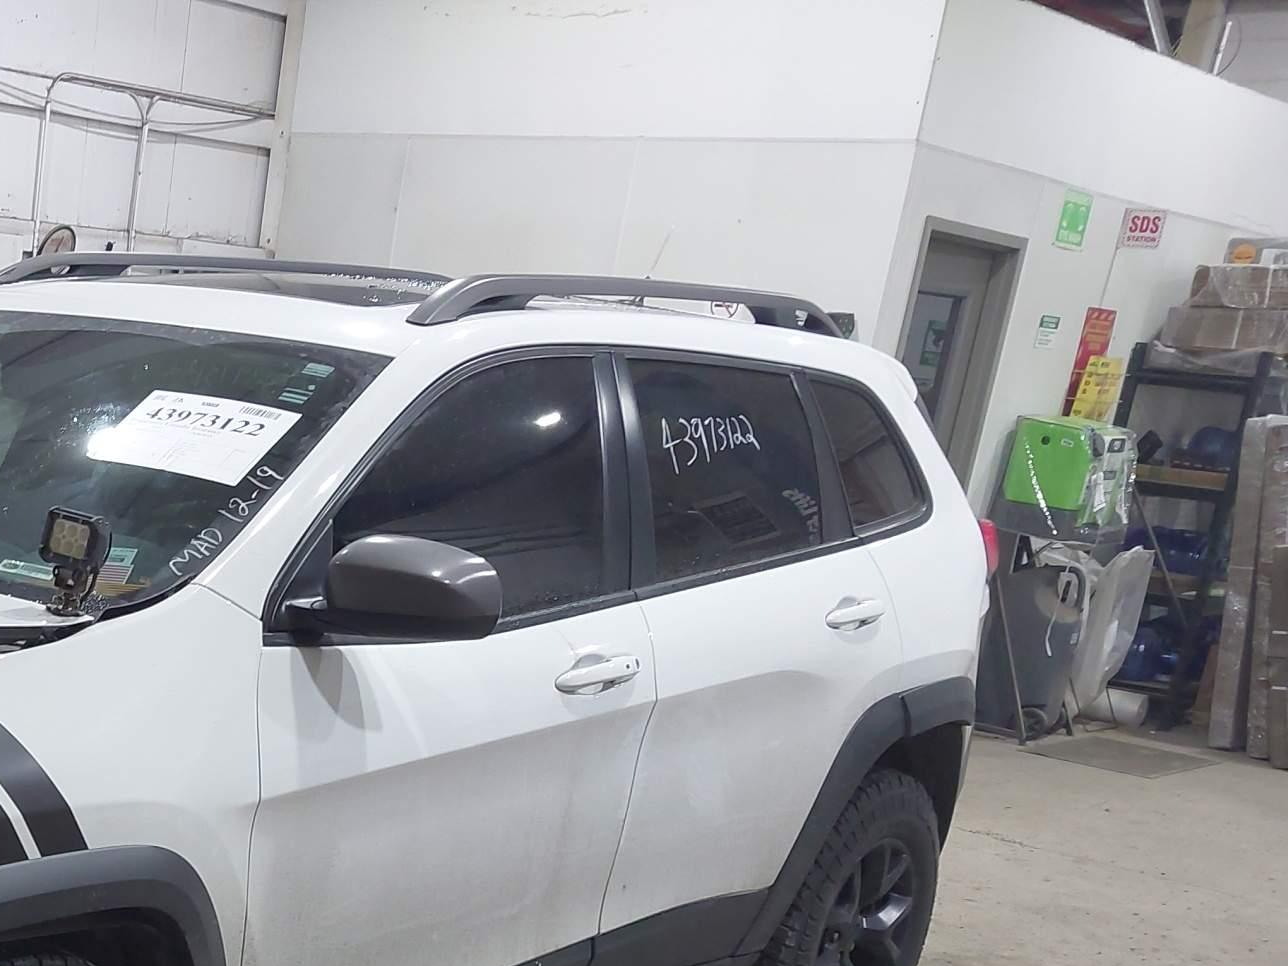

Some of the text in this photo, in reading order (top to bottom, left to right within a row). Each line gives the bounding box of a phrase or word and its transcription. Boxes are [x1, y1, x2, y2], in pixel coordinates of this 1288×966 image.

[1127, 235, 1157, 243] STATION
[1129, 215, 1161, 234] SDS
[145, 406, 267, 438] 43973122
[661, 413, 761, 475] 43973122
[168, 465, 284, 577] MAD 12-19
